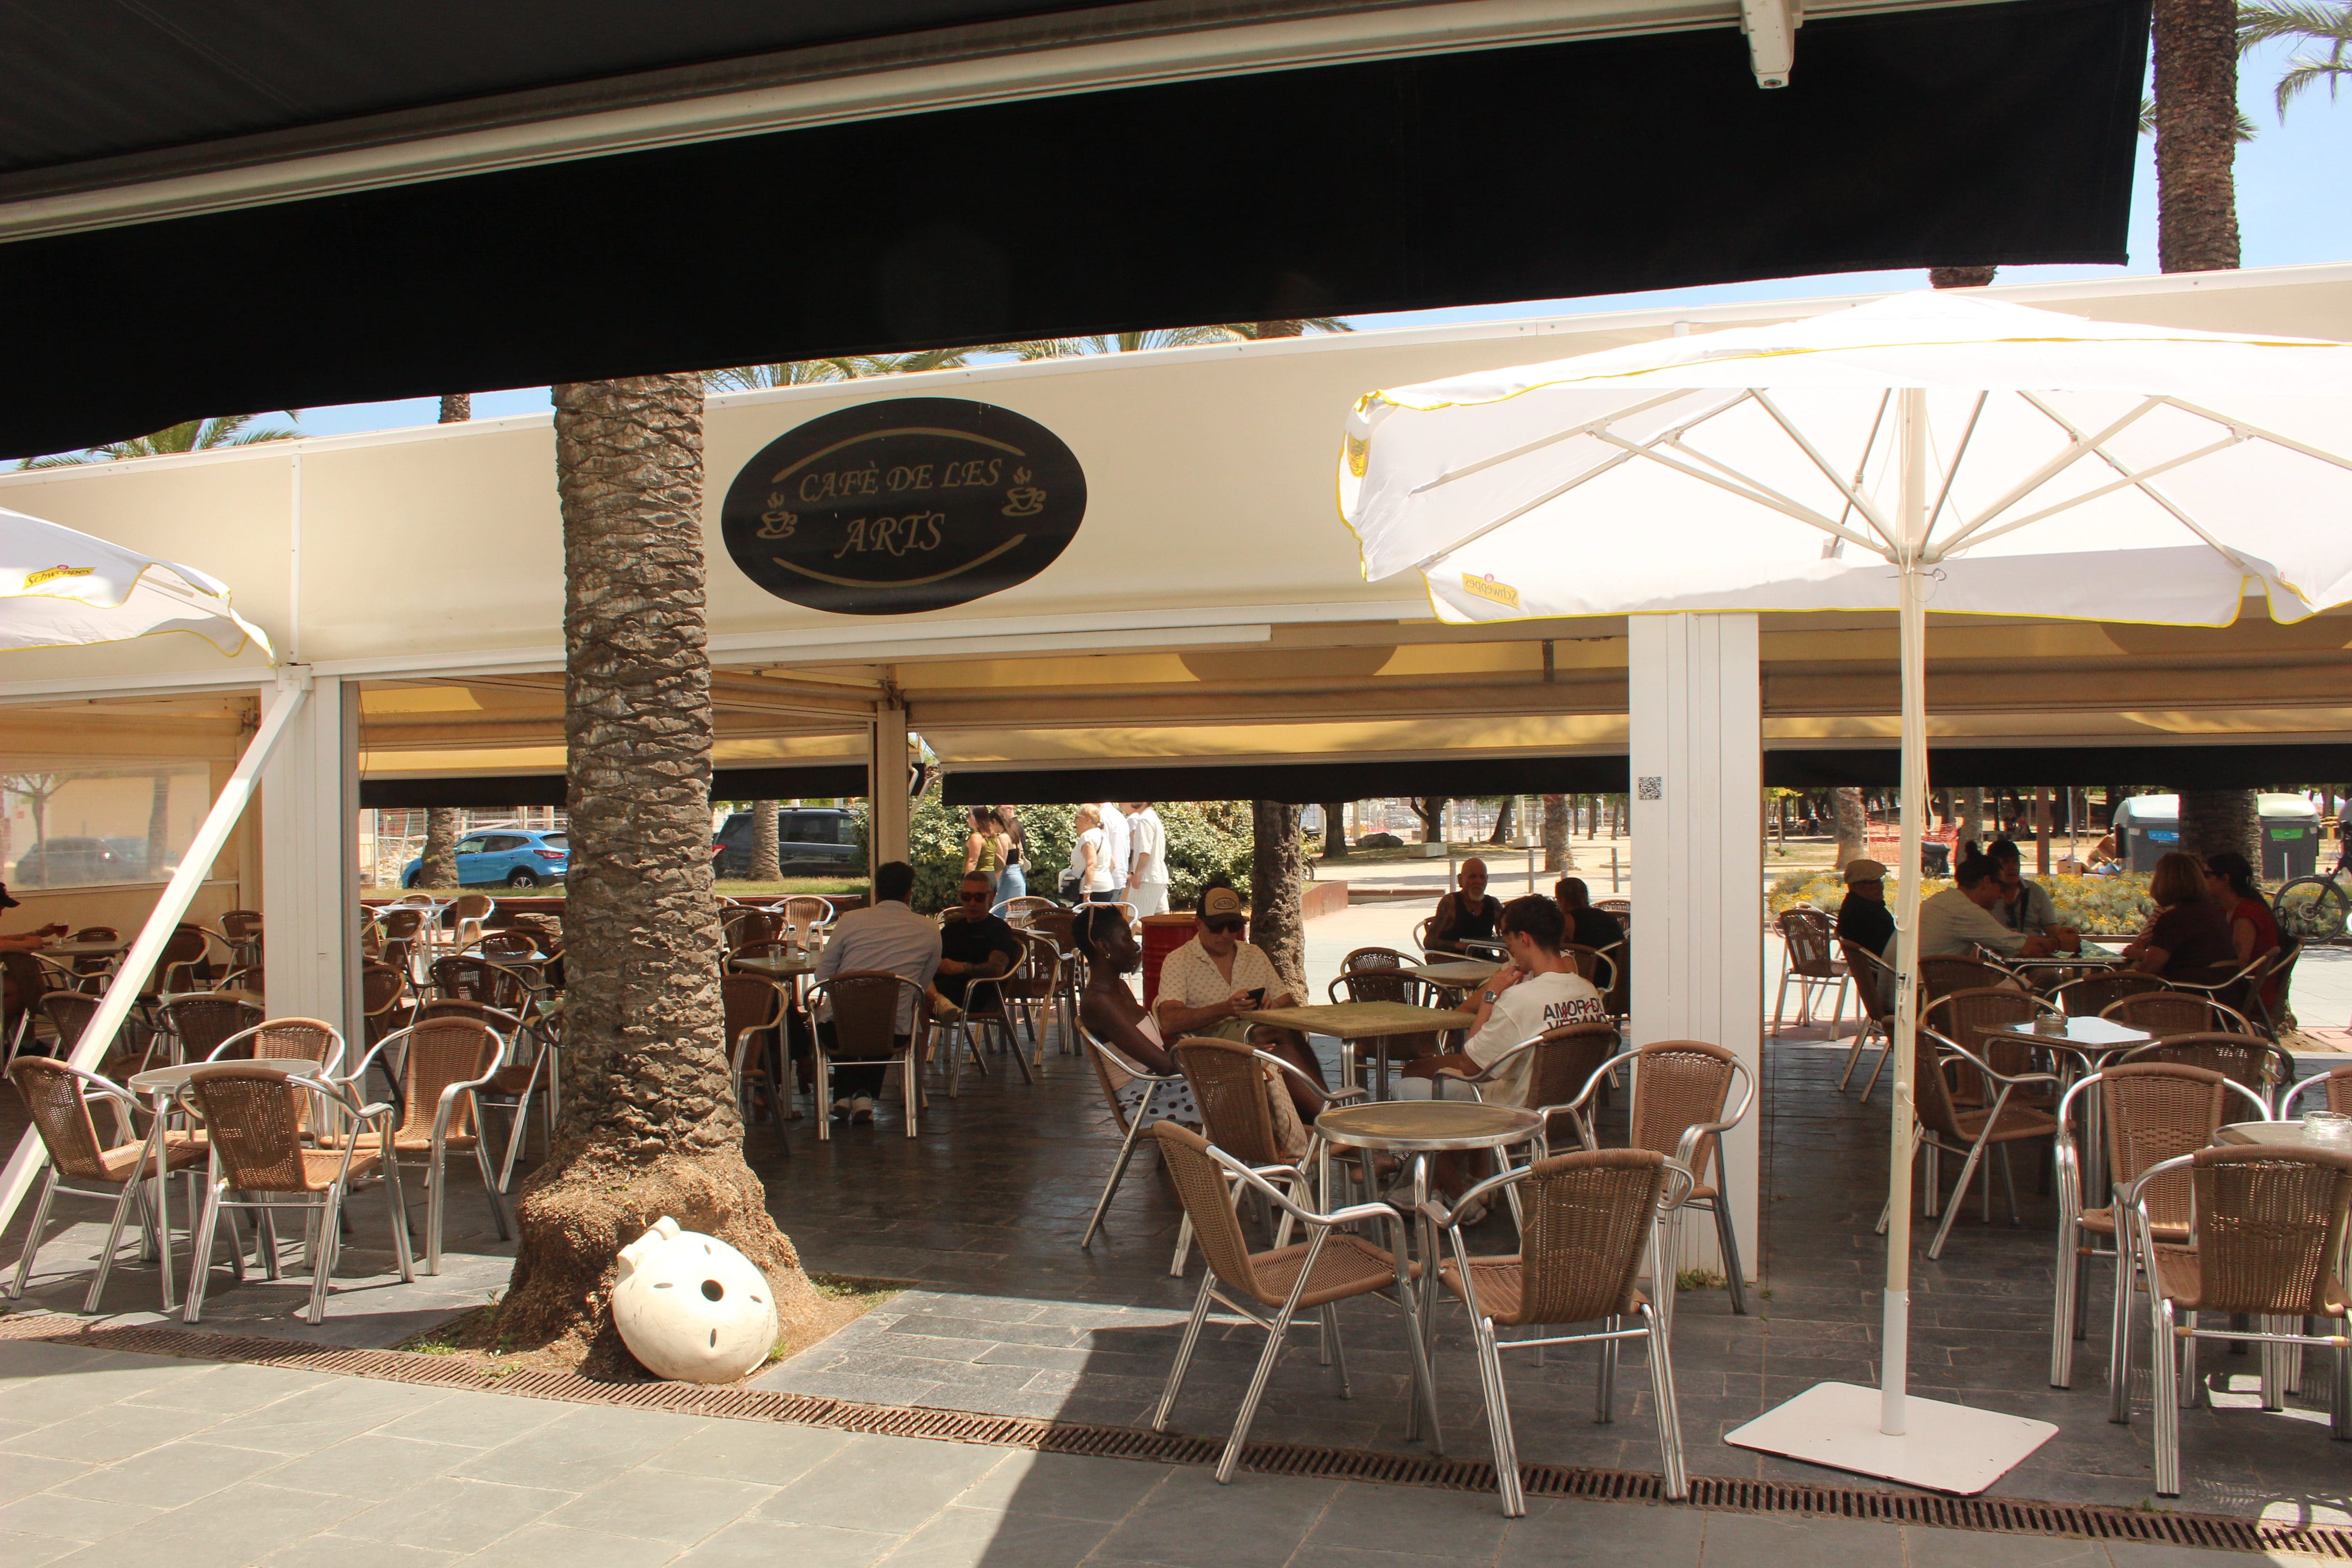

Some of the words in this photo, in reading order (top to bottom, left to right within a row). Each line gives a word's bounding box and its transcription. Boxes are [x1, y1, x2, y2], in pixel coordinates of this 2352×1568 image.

[799, 460, 879, 502] CAFÈ
[887, 464, 933, 492] DE
[940, 458, 1002, 488] LES
[833, 510, 945, 559] ARTS
[26, 569, 90, 588] Schweppes
